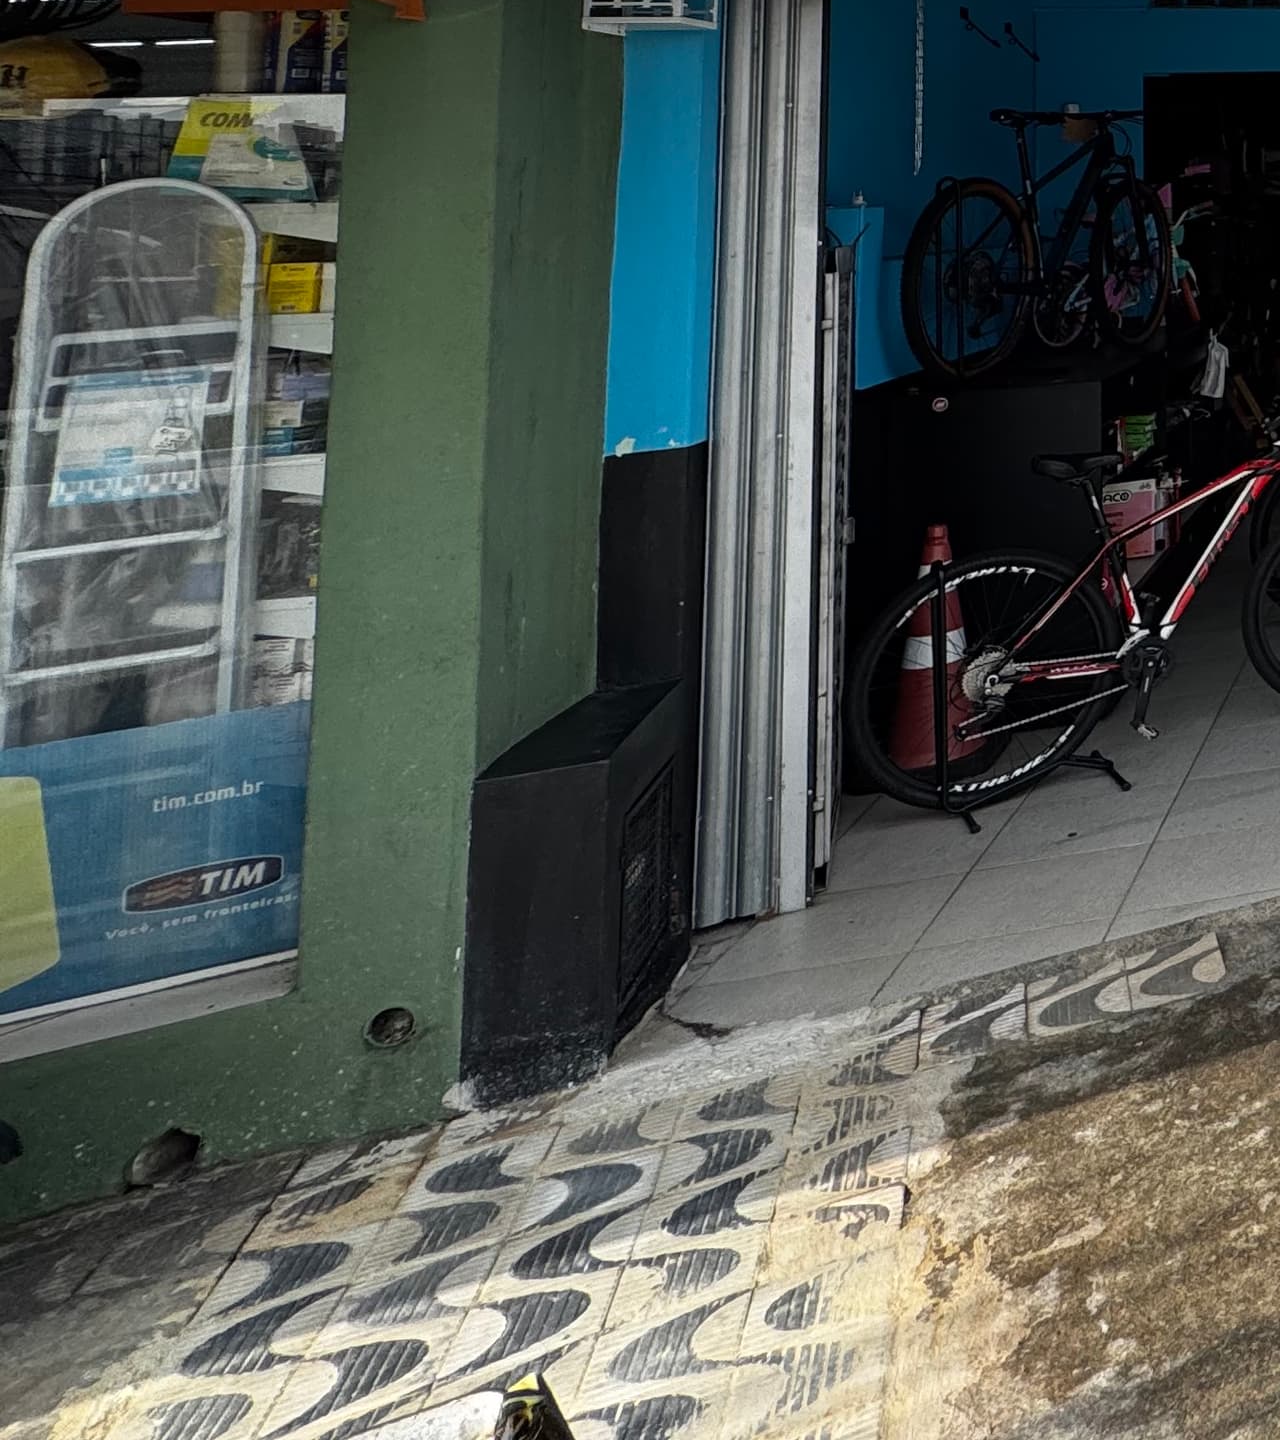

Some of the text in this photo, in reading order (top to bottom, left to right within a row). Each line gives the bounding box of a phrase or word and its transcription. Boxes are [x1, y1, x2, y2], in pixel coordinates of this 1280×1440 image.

[200, 111, 254, 128] COM
[152, 779, 266, 813] tim.com.br
[200, 860, 267, 896] TIM
[162, 913, 198, 929] sem
